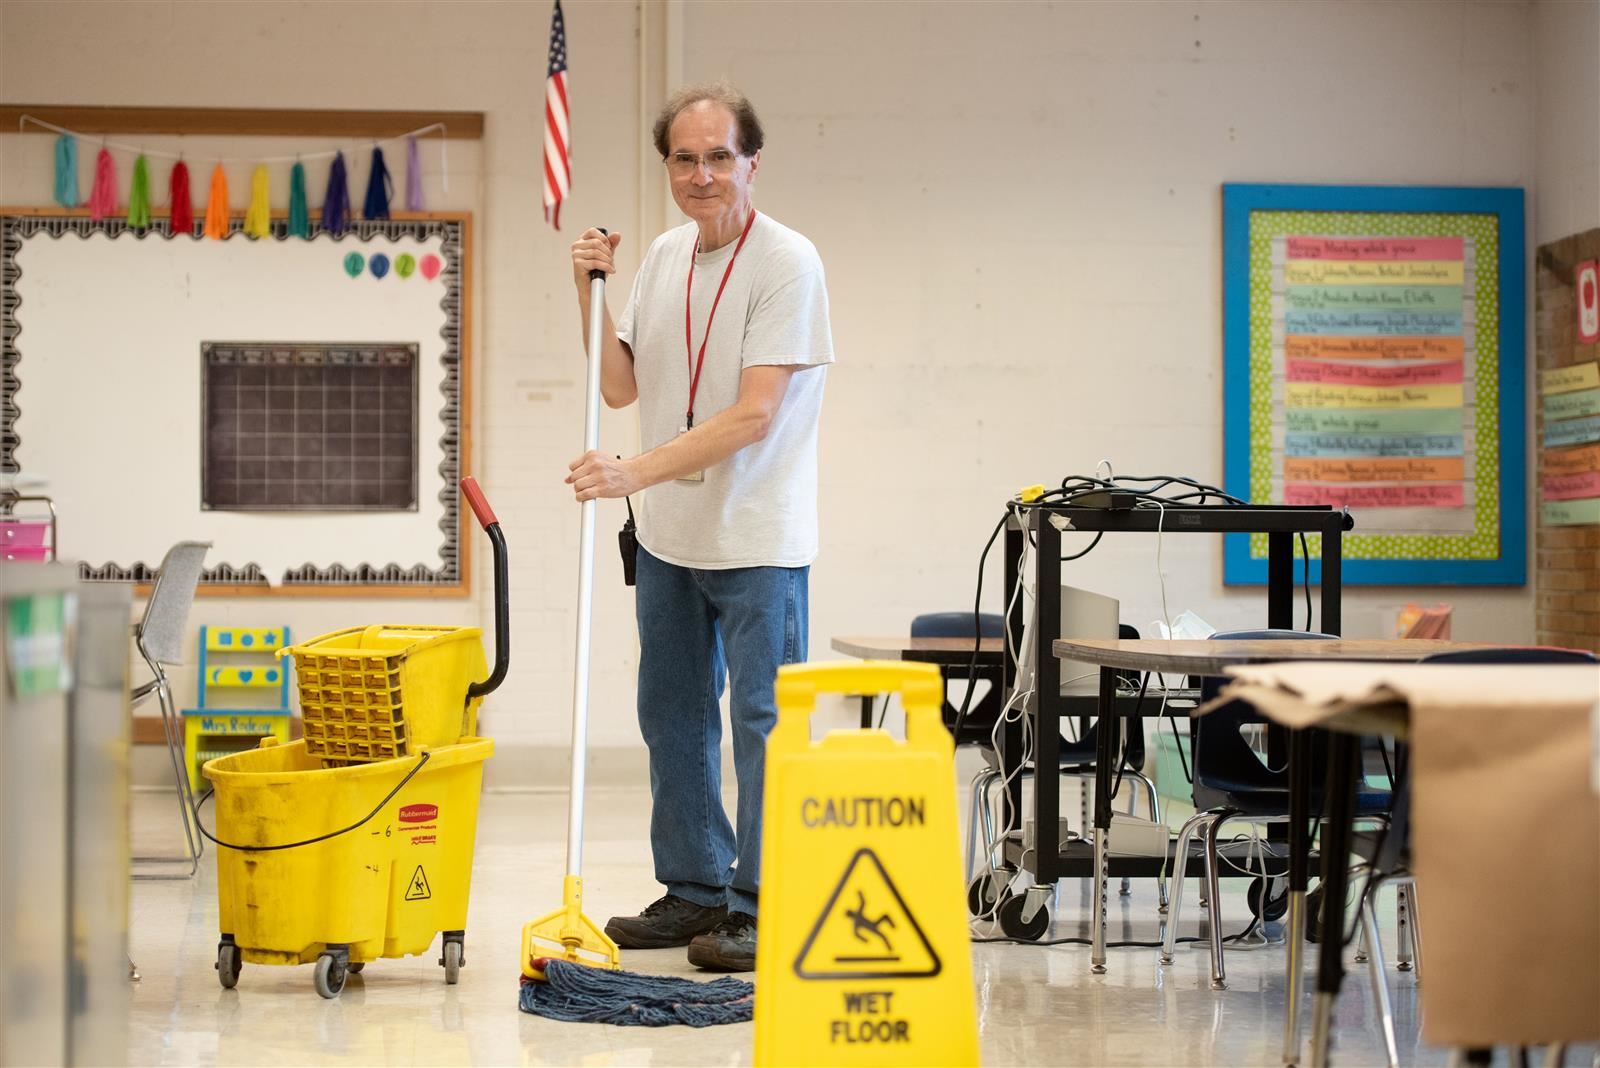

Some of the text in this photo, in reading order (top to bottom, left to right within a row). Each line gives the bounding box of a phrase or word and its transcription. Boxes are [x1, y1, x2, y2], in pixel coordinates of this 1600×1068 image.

[400, 808, 436, 818] Rubbermaid
[801, 797, 925, 828] CAUTION
[385, 824, 392, 837] 6
[843, 990, 894, 1015] WET
[830, 1021, 911, 1045] FLOOR
